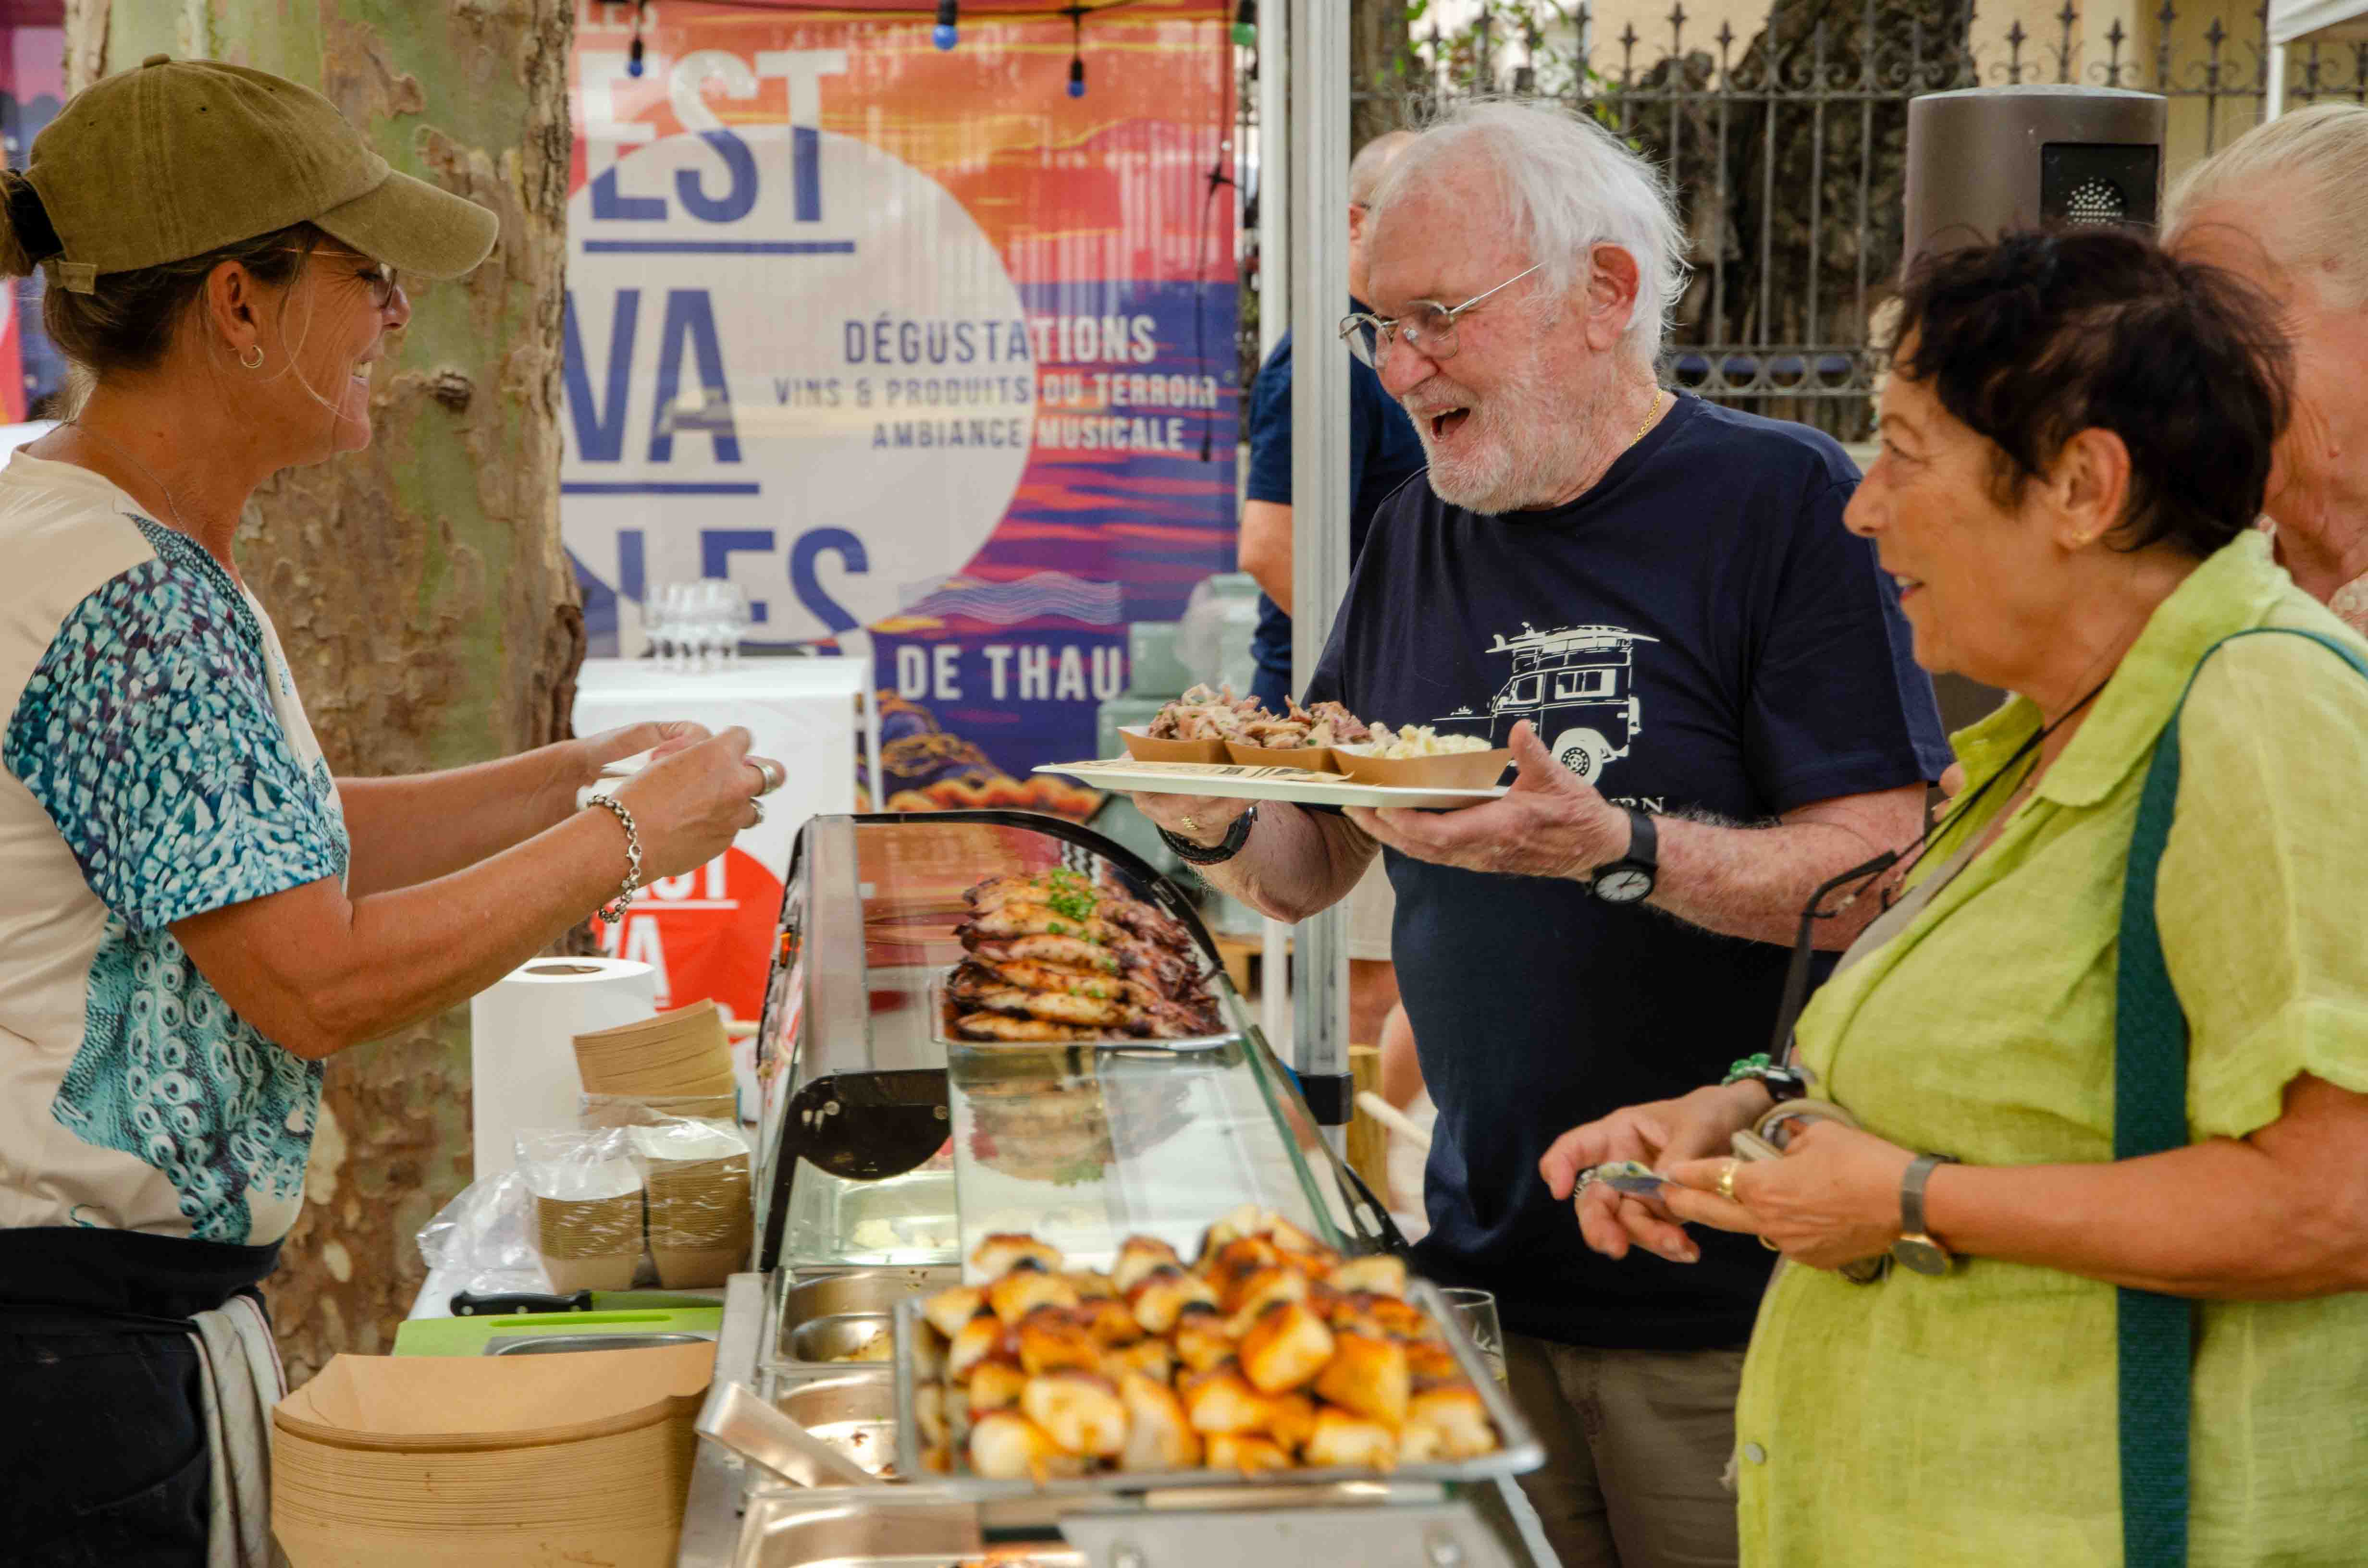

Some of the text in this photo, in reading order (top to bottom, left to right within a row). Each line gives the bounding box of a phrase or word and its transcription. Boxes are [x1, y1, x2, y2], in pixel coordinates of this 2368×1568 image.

[579, 49, 849, 223] EST
[844, 311, 1156, 364] DÉGUSTATIONS
[774, 377, 841, 407] VINS
[886, 376, 1031, 407] PRODUITS
[1043, 374, 1084, 405] DU
[1092, 373, 1218, 408] TERROIR
[872, 417, 1185, 450] AMBIANCE MUSICALE
[897, 644, 1122, 701] DE THAU
